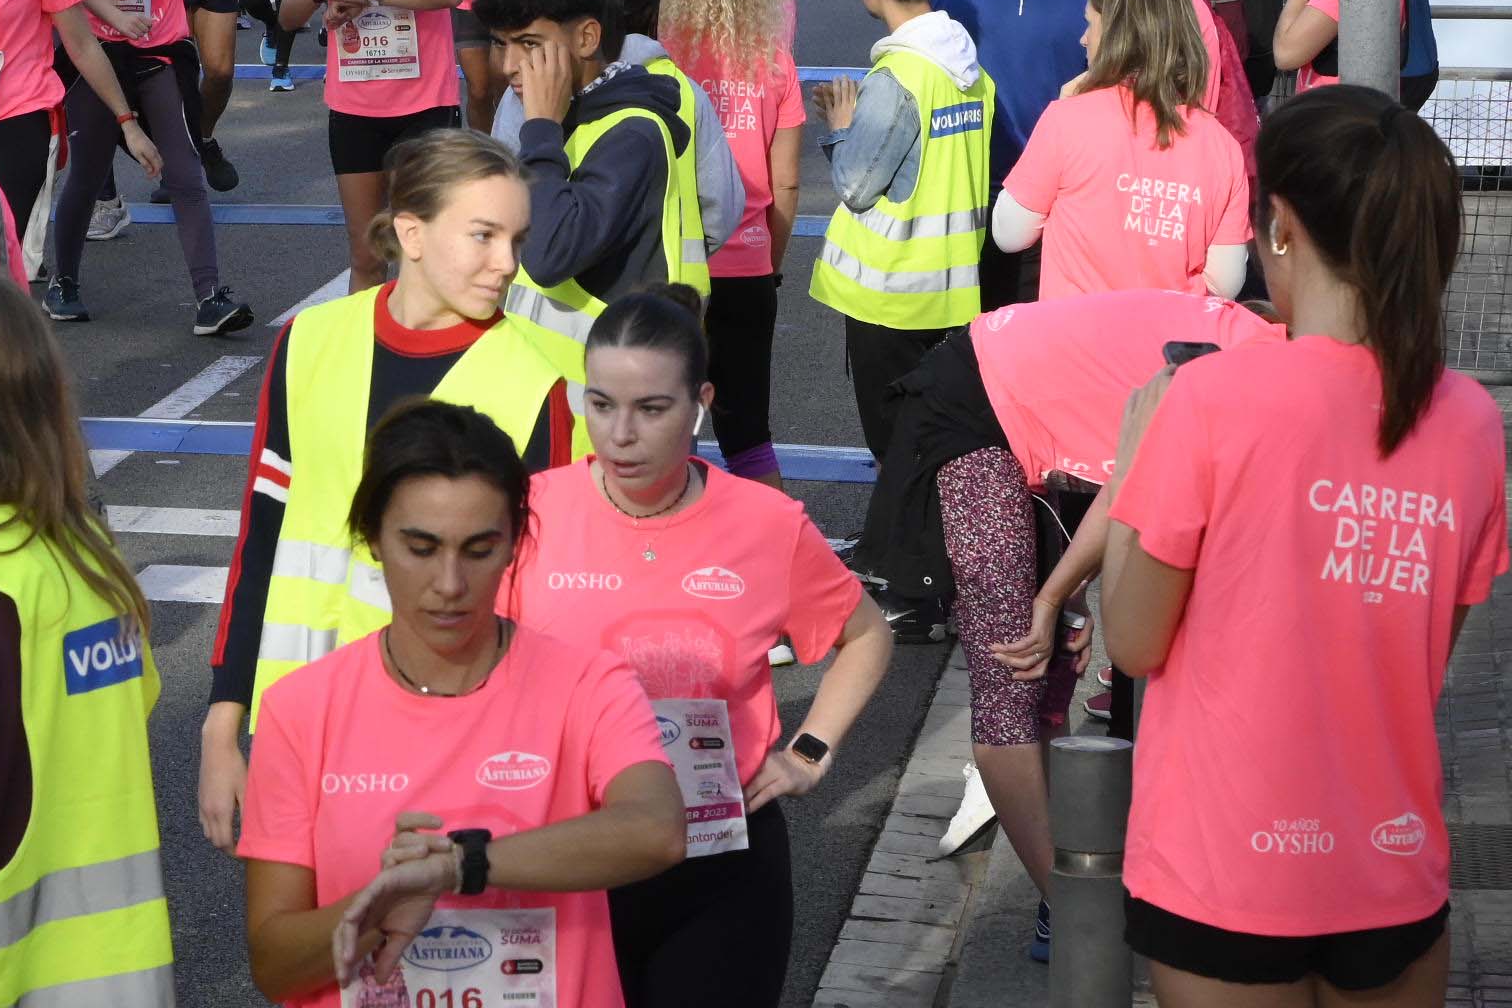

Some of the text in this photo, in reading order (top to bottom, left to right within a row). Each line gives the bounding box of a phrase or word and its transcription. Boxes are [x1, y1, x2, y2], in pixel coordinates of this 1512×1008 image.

[362, 36, 389, 47] 016
[365, 49, 386, 57] 16713
[735, 98, 753, 113] LA
[719, 115, 756, 130] UJER
[1116, 174, 1201, 205] CARRERA
[1132, 195, 1183, 222] DE LA
[1309, 479, 1455, 532] CARRERA
[1335, 518, 1426, 560] DE LA
[1321, 550, 1430, 595] MUJER
[548, 573, 622, 591] OYSHO
[687, 577, 743, 593] ASTURIANA
[481, 764, 547, 782] ASTURIANA
[323, 773, 408, 794] OYSHO
[704, 808, 727, 818] 2023
[1273, 820, 1286, 831] 10
[688, 829, 734, 843] antander
[1251, 831, 1334, 854] OYSHO
[500, 935, 543, 945] SUMA
[410, 944, 485, 960] ASTURIANA
[416, 987, 483, 1008] 016
